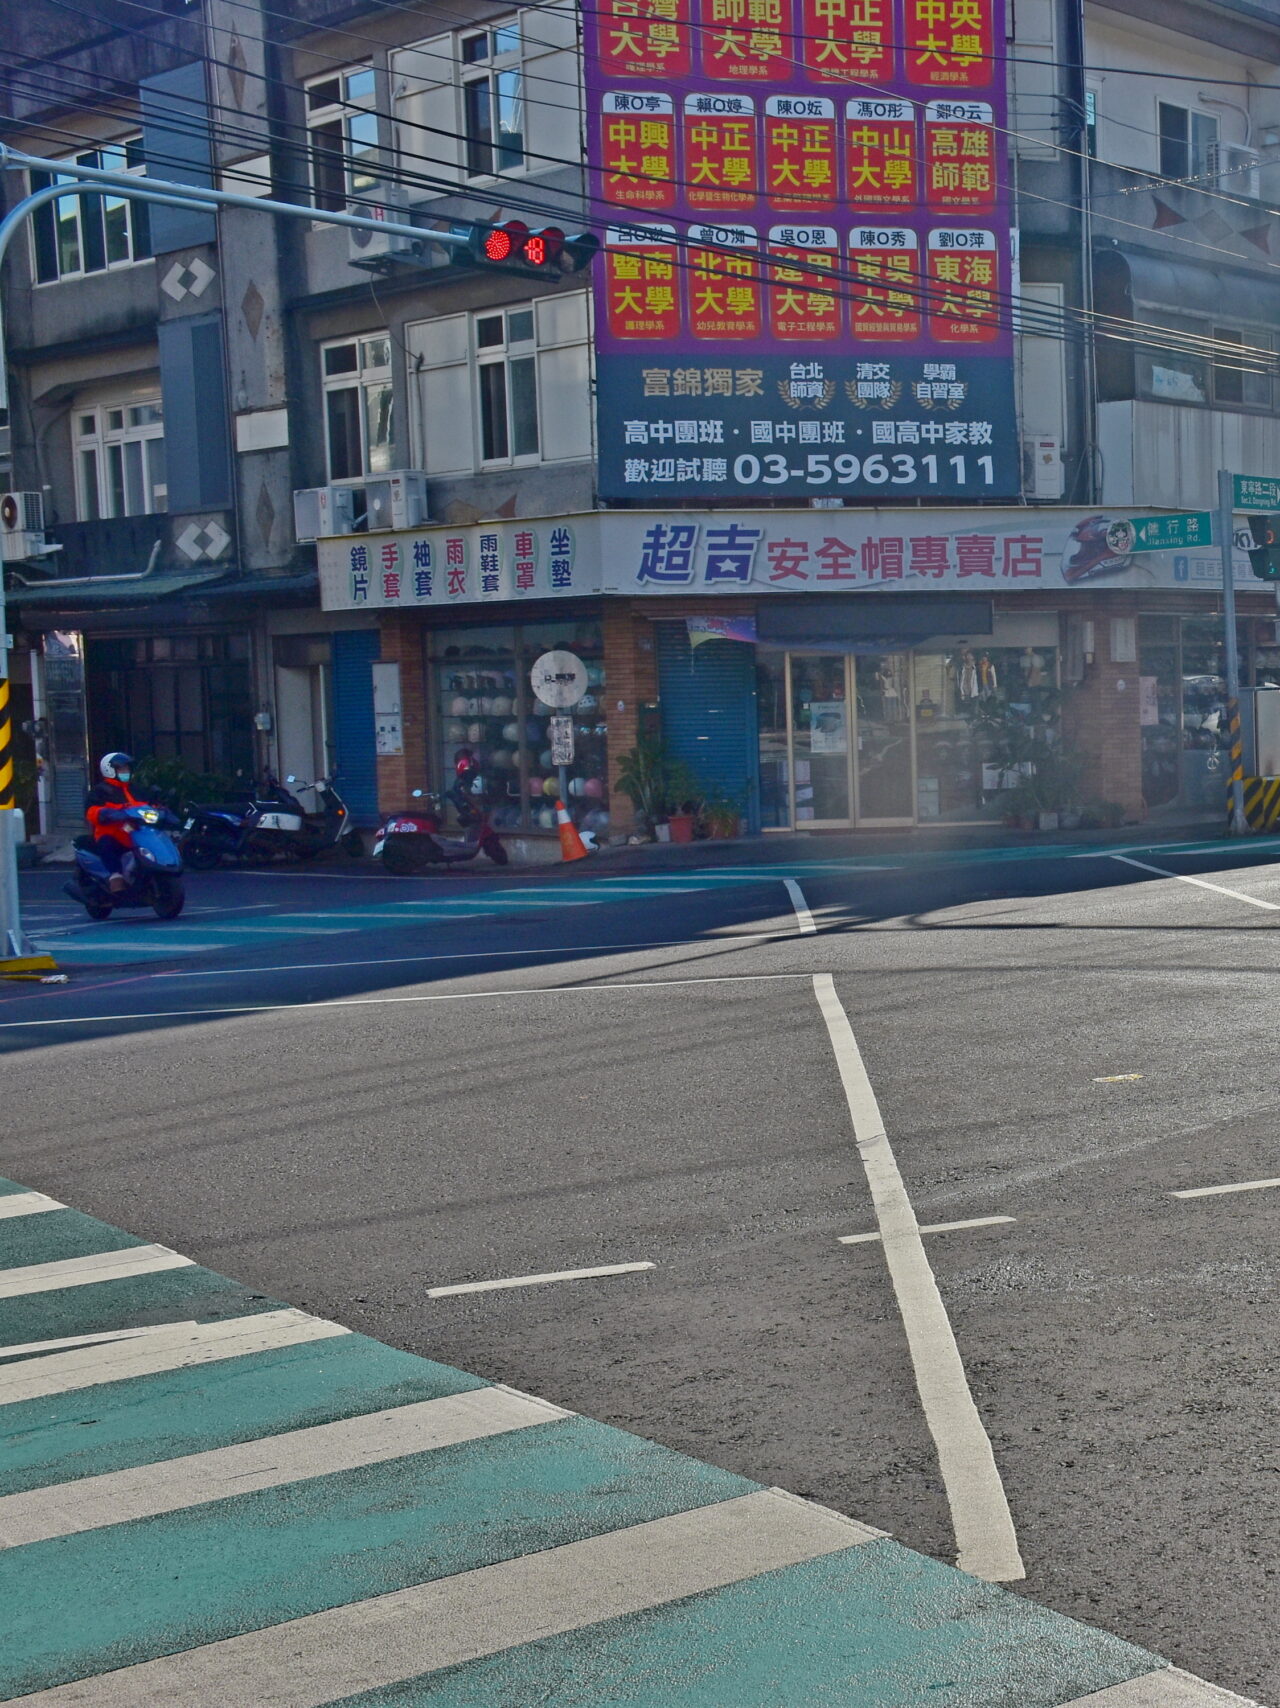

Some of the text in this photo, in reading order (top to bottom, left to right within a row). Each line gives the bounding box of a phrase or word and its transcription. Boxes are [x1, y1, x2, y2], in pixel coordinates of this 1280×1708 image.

[815, 0, 883, 27] 中正
[916, 0, 982, 30] 中央
[610, 22, 680, 57] 大學
[713, 26, 782, 61] 大學
[815, 29, 883, 64] 大學
[916, 33, 982, 67] 大學
[608, 119, 669, 149] 中興
[691, 121, 750, 151] 中正
[772, 123, 831, 153] 中正
[852, 126, 911, 156] 中山
[931, 128, 989, 157] 高雄
[609, 155, 669, 184] 大學
[691, 156, 751, 185] 大學
[772, 158, 831, 188] 大學
[852, 159, 912, 189] 大學
[932, 161, 990, 191] 師範
[613, 251, 672, 280] 暨南
[694, 252, 753, 281] 北市
[855, 253, 913, 284] 東吳
[934, 255, 992, 286] 東海
[614, 285, 674, 315] 大學
[695, 287, 755, 315] 大學
[776, 287, 835, 317] 大學
[857, 288, 914, 318] 大學
[936, 289, 993, 319] 大學
[950, 323, 979, 335] 化學系
[642, 367, 765, 398] 富錦獨家
[789, 362, 824, 380] 台北
[856, 363, 890, 380] 清交
[923, 364, 957, 381] 學霸
[789, 381, 825, 399] 師資
[857, 382, 891, 399] 團隊
[916, 382, 965, 400] 自習室
[624, 453, 995, 485] 歡迎試聽 03-5963111
[350, 545, 368, 600] 鏡片
[381, 543, 400, 599] 手套
[413, 540, 433, 597] 袖套
[445, 538, 466, 595] 雨衣
[479, 534, 500, 593] 雨鞋套
[513, 531, 536, 590] 車罩
[550, 527, 572, 589] 坐墊
